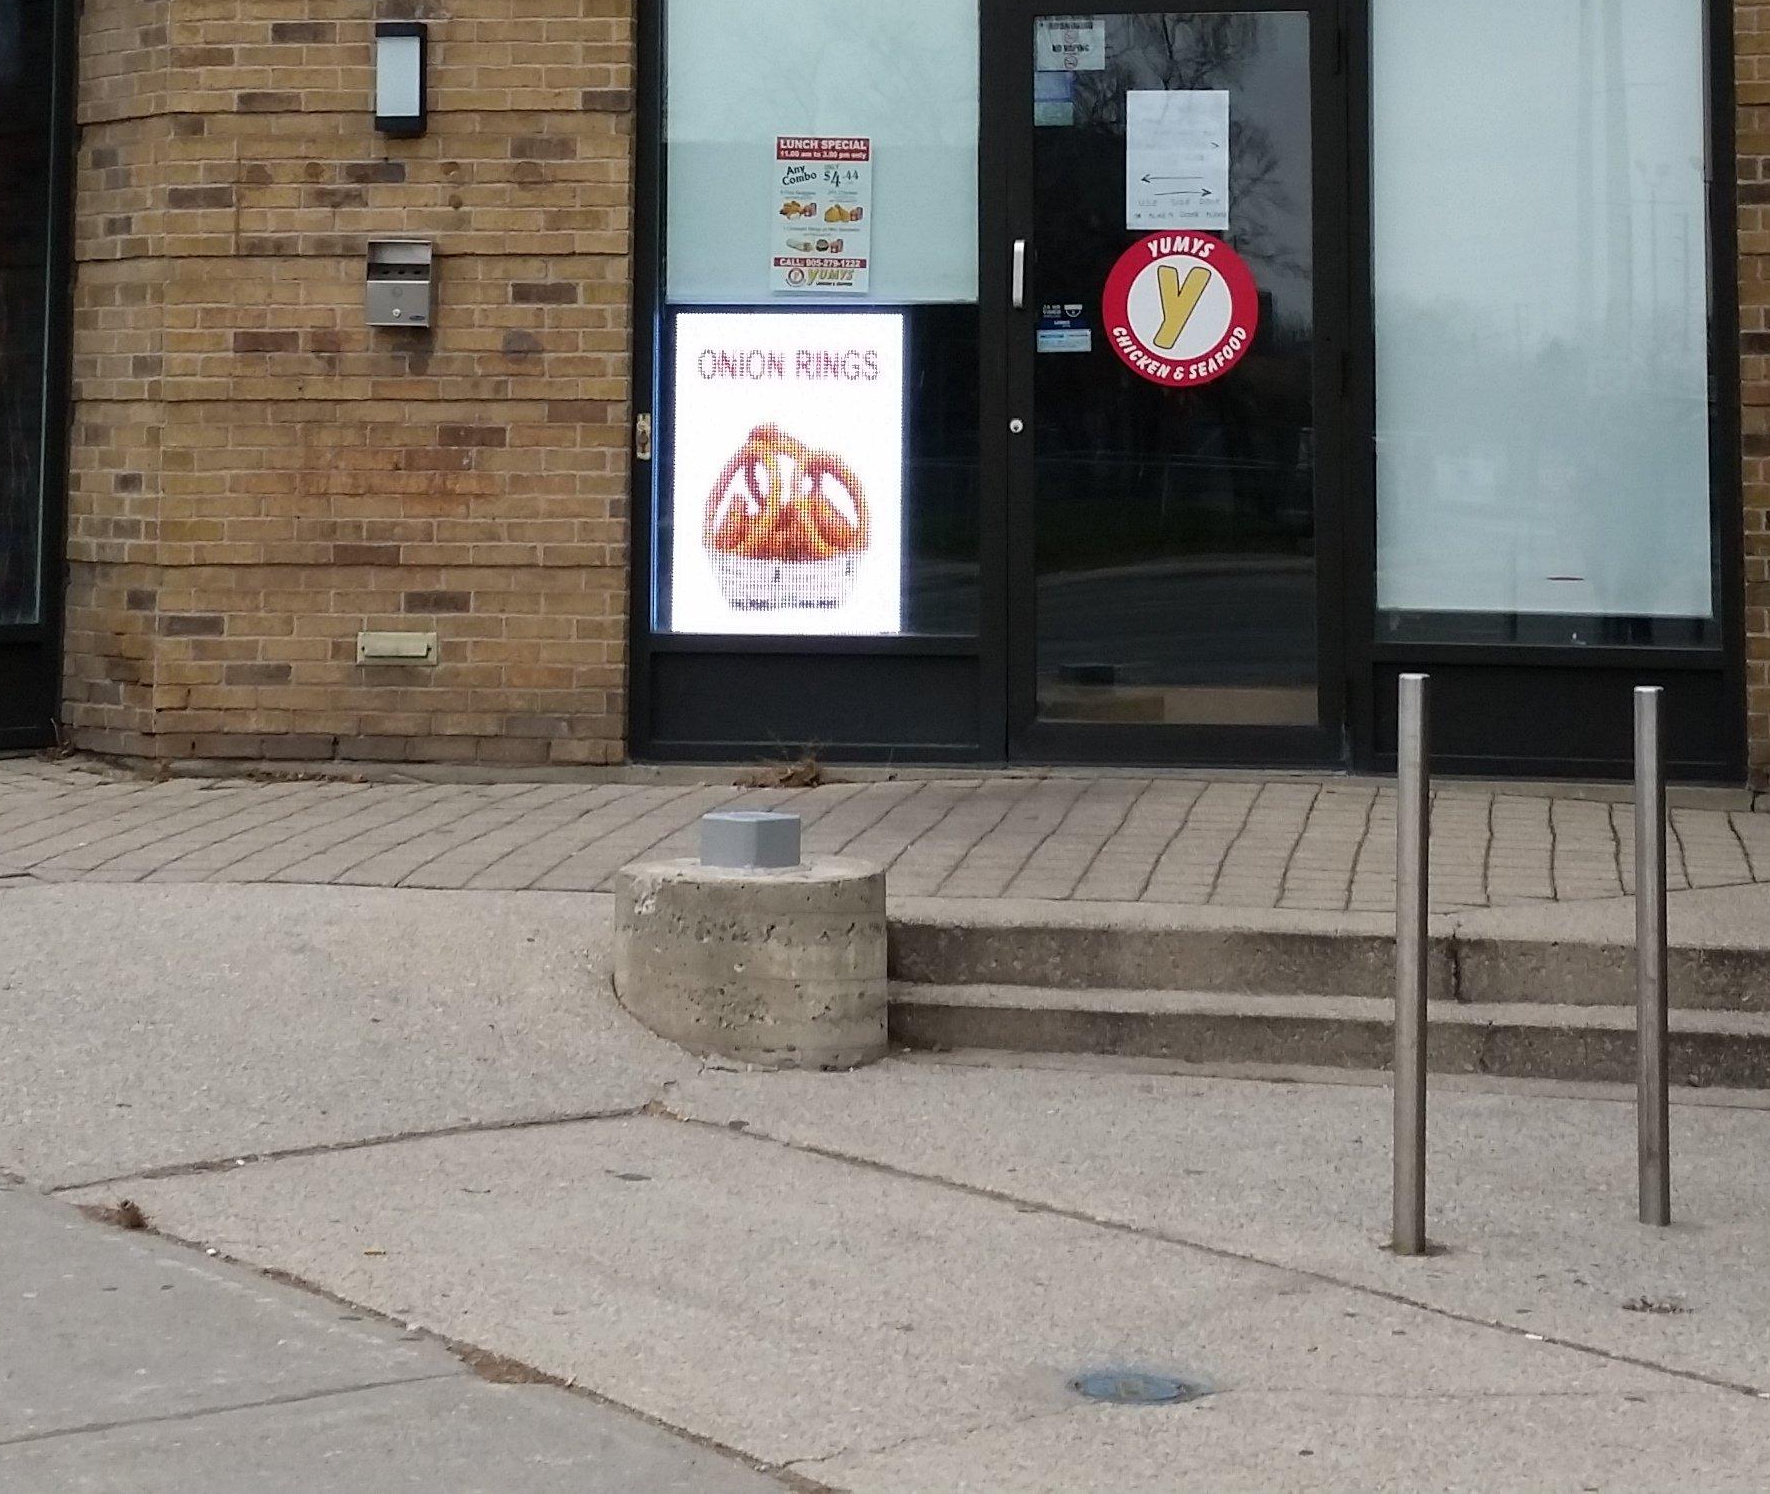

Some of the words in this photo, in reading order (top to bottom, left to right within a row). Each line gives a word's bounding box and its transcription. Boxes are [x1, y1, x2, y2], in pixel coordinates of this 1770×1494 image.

[779, 139, 818, 149] LUNCH
[820, 140, 867, 150] SPECIAL
[782, 172, 817, 186] Combo
[786, 165, 805, 175] Any
[1147, 236, 1215, 258] YUMYS
[1112, 326, 1171, 379] CHICKEN
[1173, 367, 1185, 381] &
[1188, 326, 1247, 380] SEAFOOD
[697, 348, 786, 381] ONION
[795, 348, 879, 381] RINGS
